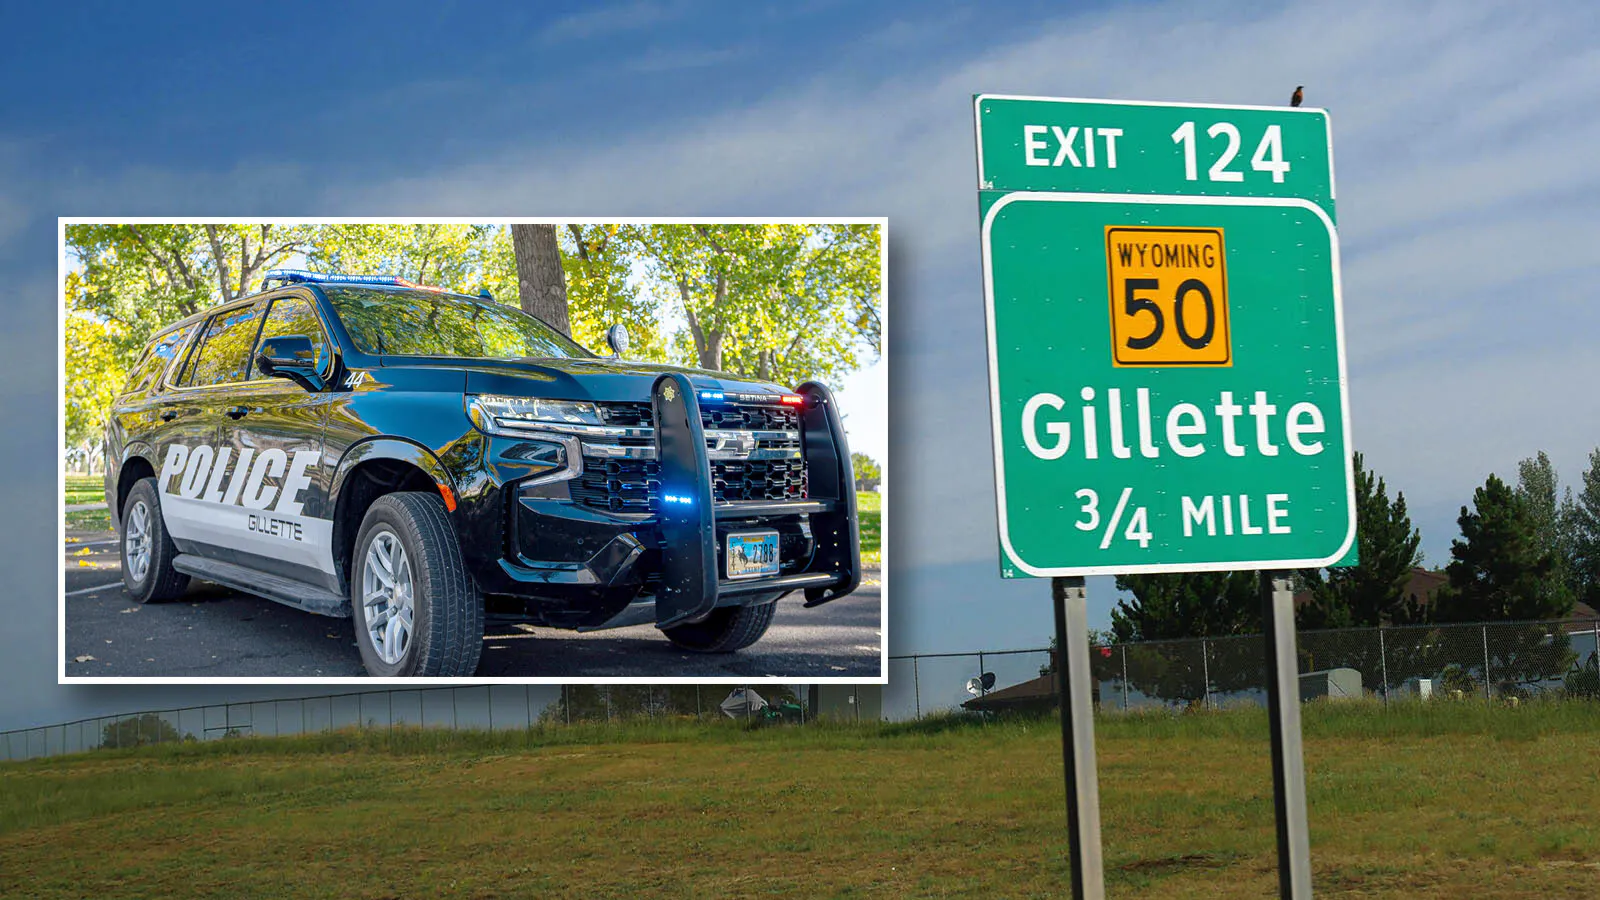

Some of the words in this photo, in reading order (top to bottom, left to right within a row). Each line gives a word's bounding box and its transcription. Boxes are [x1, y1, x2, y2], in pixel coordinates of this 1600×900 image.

[1024, 125, 1123, 168] EXIT
[1171, 121, 1291, 183] 124
[1117, 242, 1215, 268] WYOMING
[1124, 278, 1215, 350] 50
[344, 371, 365, 388] 44
[1021, 386, 1326, 460] Gillette
[158, 443, 322, 516] POLICE
[248, 514, 302, 541] GILLETTE
[1074, 487, 1152, 549] 3/4
[1181, 493, 1291, 537] MILE
[752, 543, 774, 564] 2788
